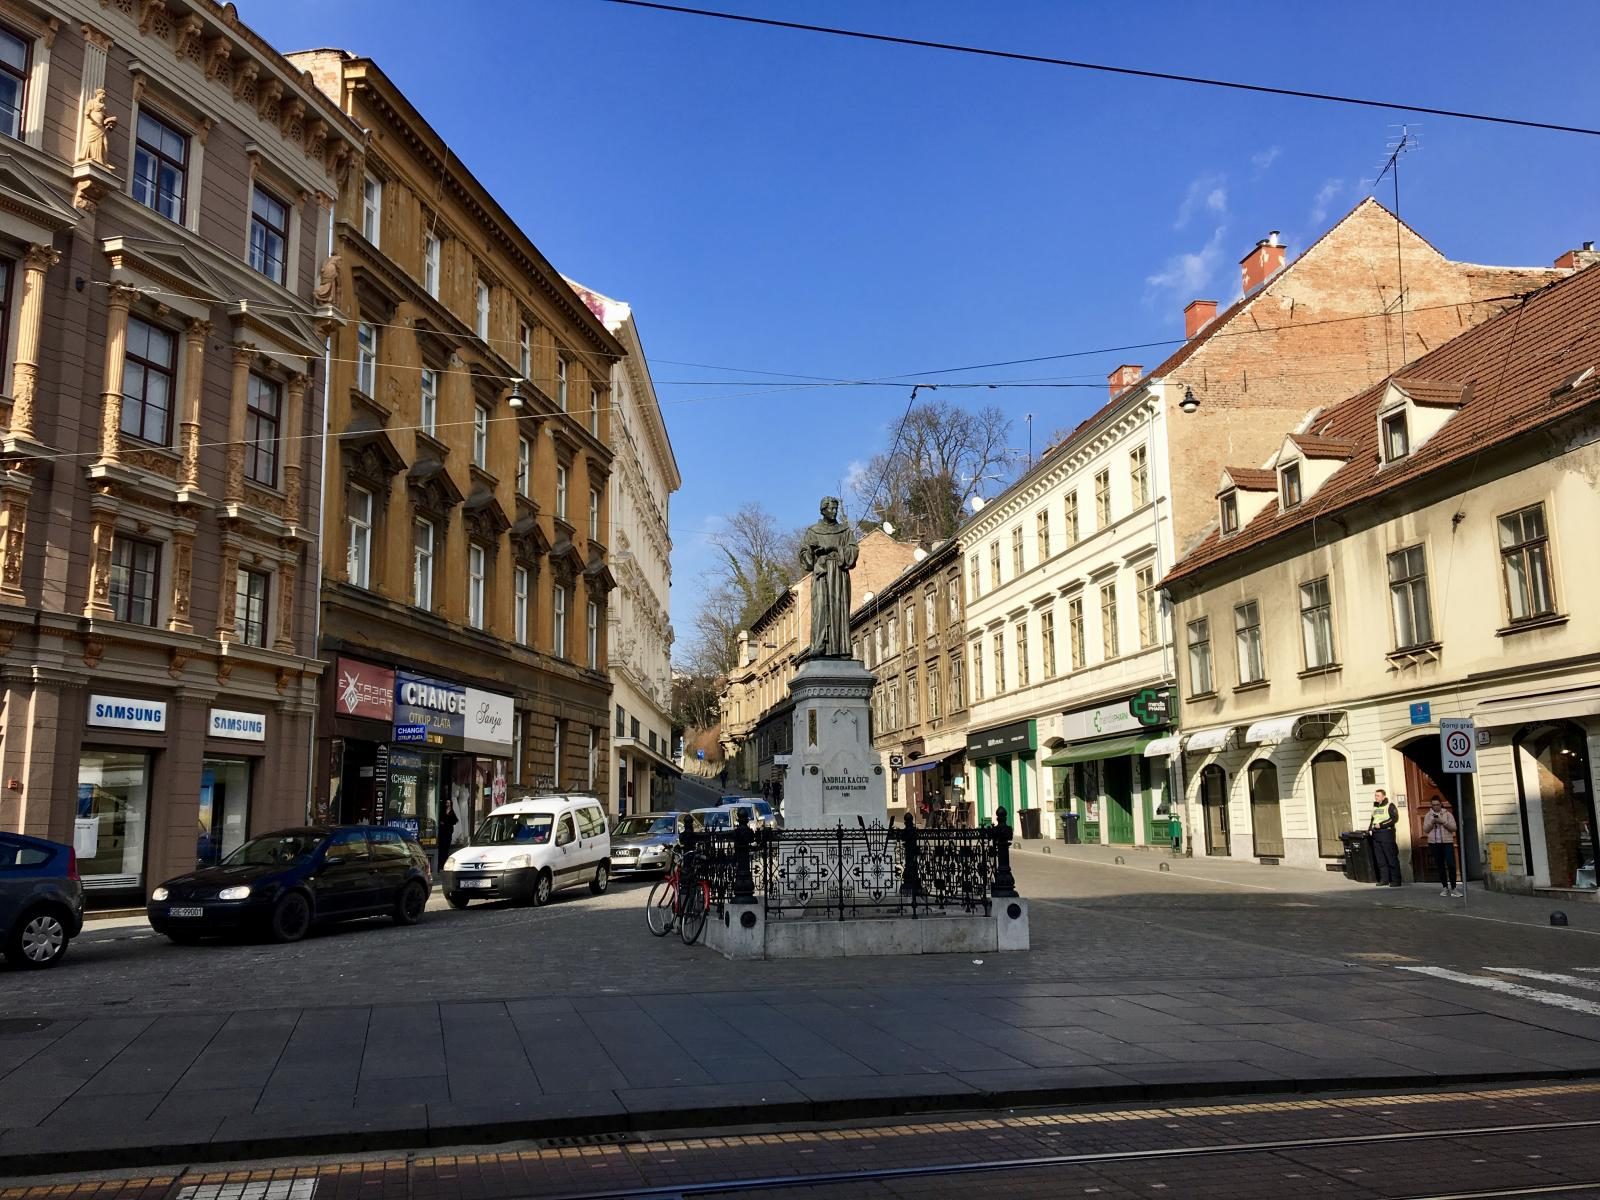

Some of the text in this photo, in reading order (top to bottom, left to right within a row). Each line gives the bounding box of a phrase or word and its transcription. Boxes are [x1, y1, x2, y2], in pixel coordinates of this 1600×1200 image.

[357, 693, 393, 707] SPORT
[402, 682, 465, 714] CHANGE
[96, 704, 161, 722] SAMSUNG
[408, 712, 431, 725] OTKUP
[433, 716, 452, 729] ZLATA
[476, 702, 502, 734] Sanja
[214, 716, 262, 733] SAMSUNG
[1452, 738, 1465, 750] 30
[1448, 760, 1471, 768] ZONA
